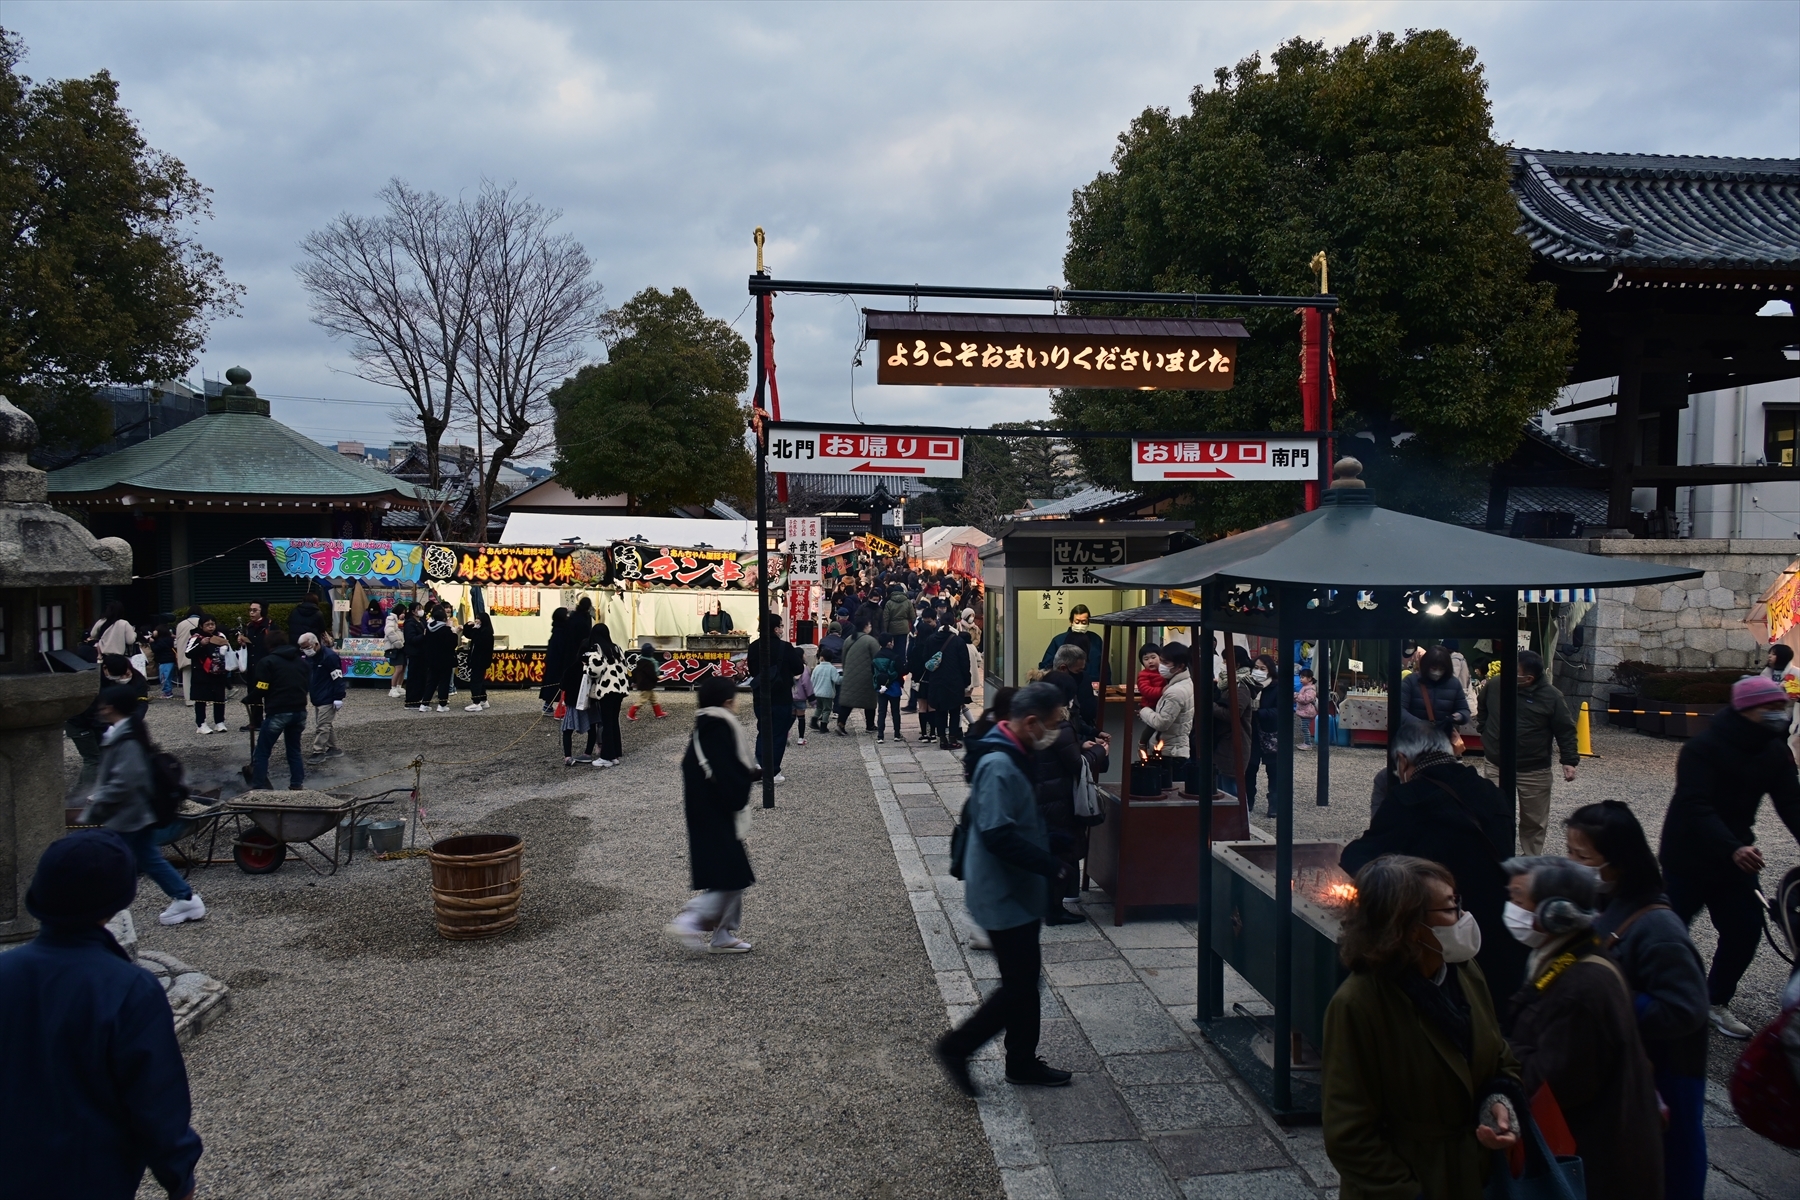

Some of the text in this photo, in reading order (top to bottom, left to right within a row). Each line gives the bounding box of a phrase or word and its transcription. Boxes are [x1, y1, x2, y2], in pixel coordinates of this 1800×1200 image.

[886, 339, 1231, 374] ようこそおまいりくださいました
[772, 438, 815, 460] 北門
[825, 435, 955, 458] お帰り口
[1142, 440, 1265, 463] お帰り口
[1271, 446, 1310, 468] 南門
[285, 547, 403, 577] みずあめ
[1055, 540, 1124, 564] せんこう
[251, 563, 266, 571] 禁煙
[457, 553, 576, 583] 肉巻きおにぎり棒
[643, 556, 745, 588] タン串
[1061, 566, 1113, 585] 志納
[1042, 589, 1051, 610] 納金
